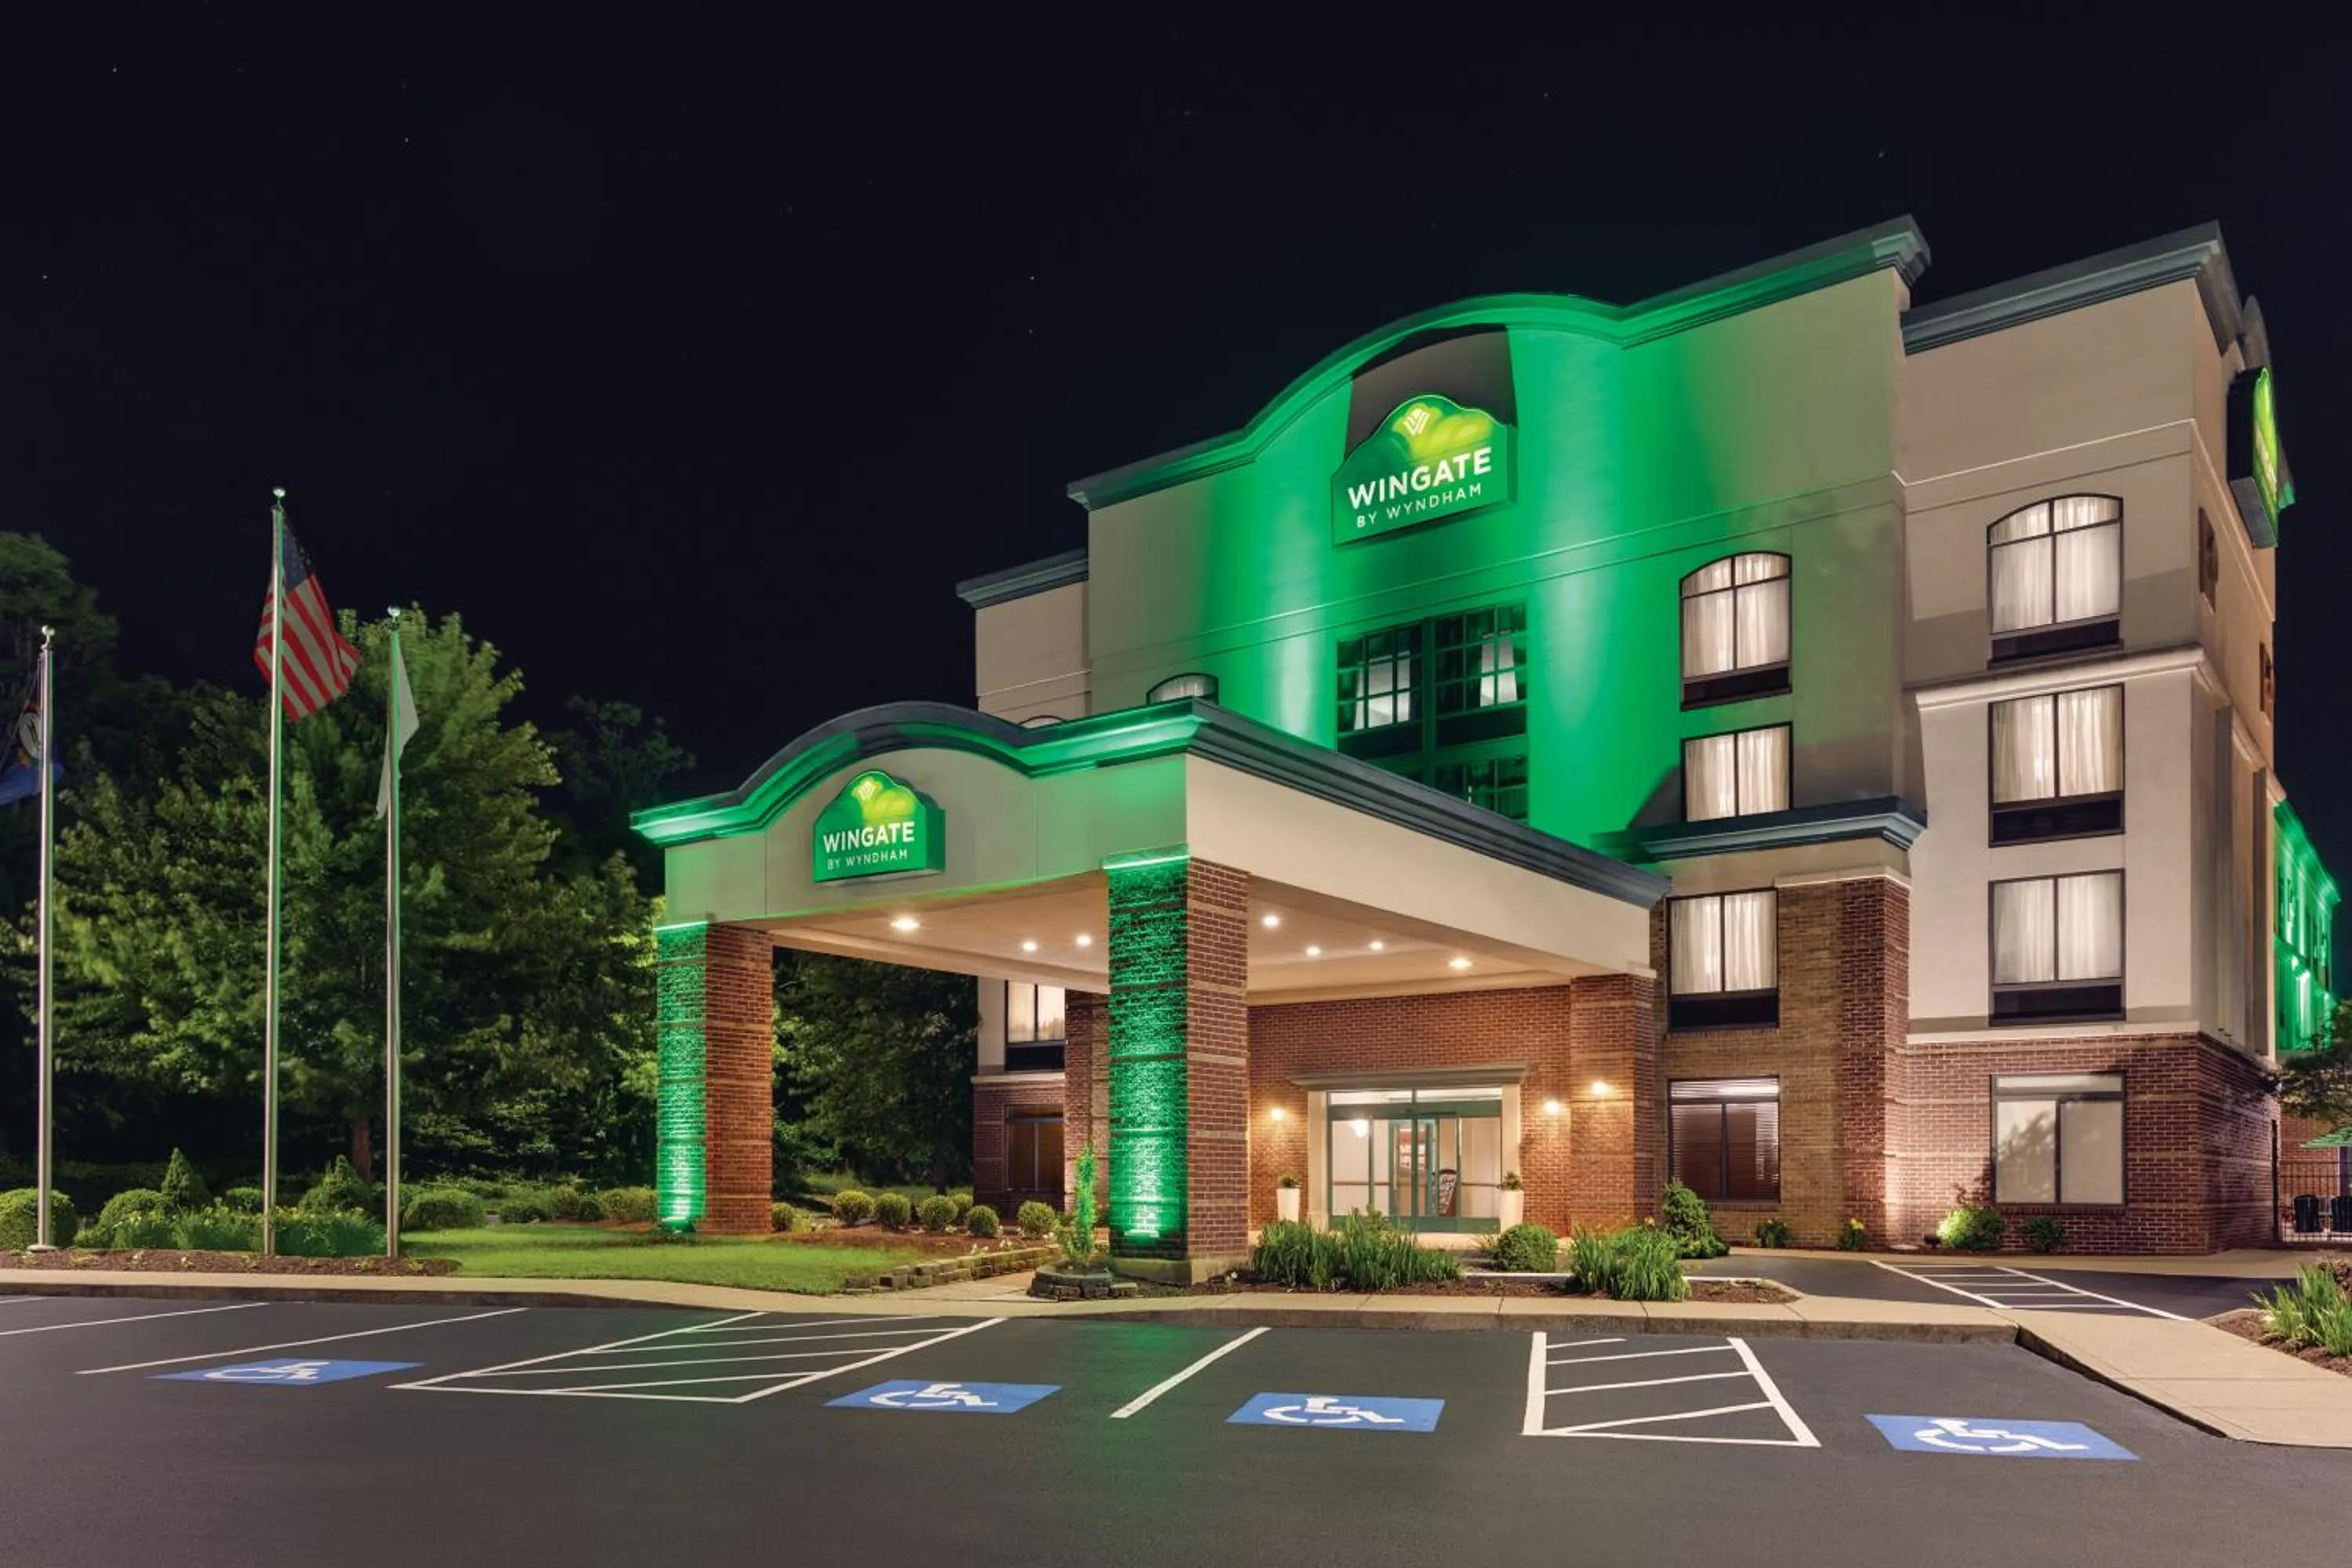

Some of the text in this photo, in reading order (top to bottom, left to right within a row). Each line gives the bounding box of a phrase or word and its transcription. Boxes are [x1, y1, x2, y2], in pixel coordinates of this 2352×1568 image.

[1348, 447, 1492, 510] WINGATE
[1357, 483, 1481, 528] BY WYNDHAM
[823, 821, 915, 853] WINGATE
[827, 849, 907, 869] BY WYNDHAM
